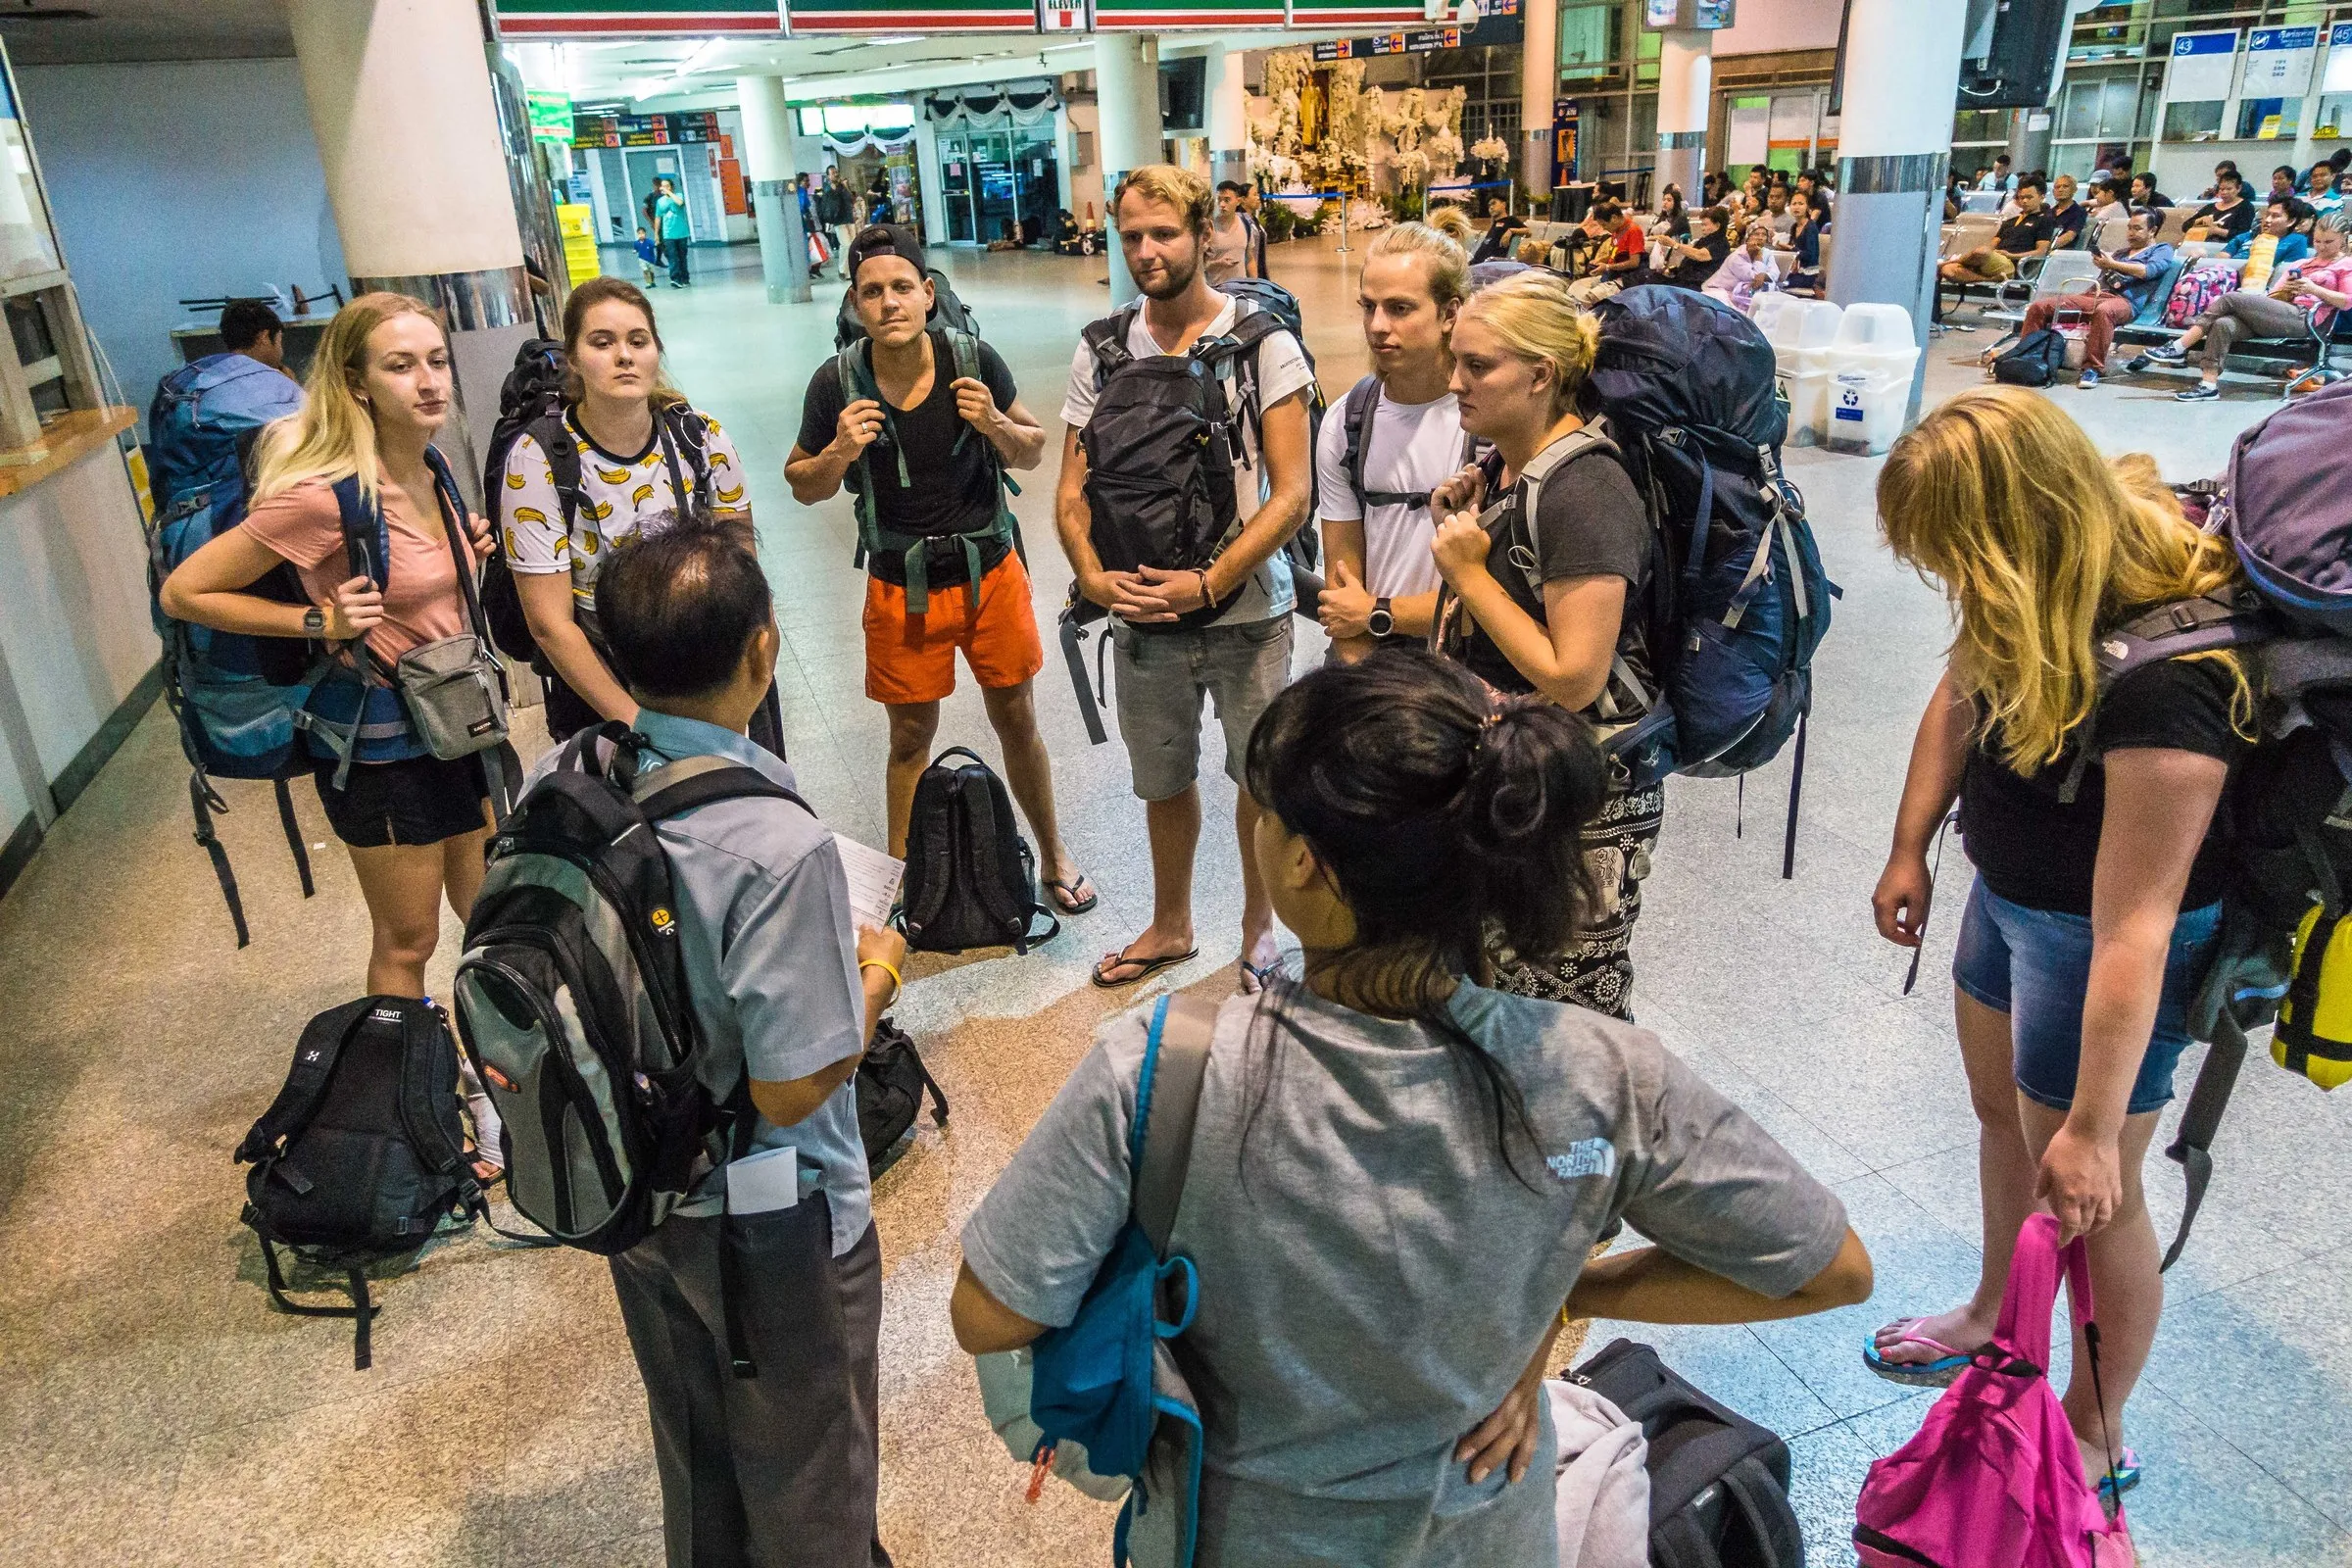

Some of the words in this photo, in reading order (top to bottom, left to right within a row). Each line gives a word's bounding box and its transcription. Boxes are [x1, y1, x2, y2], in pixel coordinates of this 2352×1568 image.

[2178, 40, 2191, 51] 43
[658, 919, 676, 933] POWER
[374, 1008, 402, 1019] TIGHT
[1569, 1139, 1593, 1154] THE
[1545, 1152, 1594, 1169] NORTH
[1557, 1163, 1591, 1179] FACE
